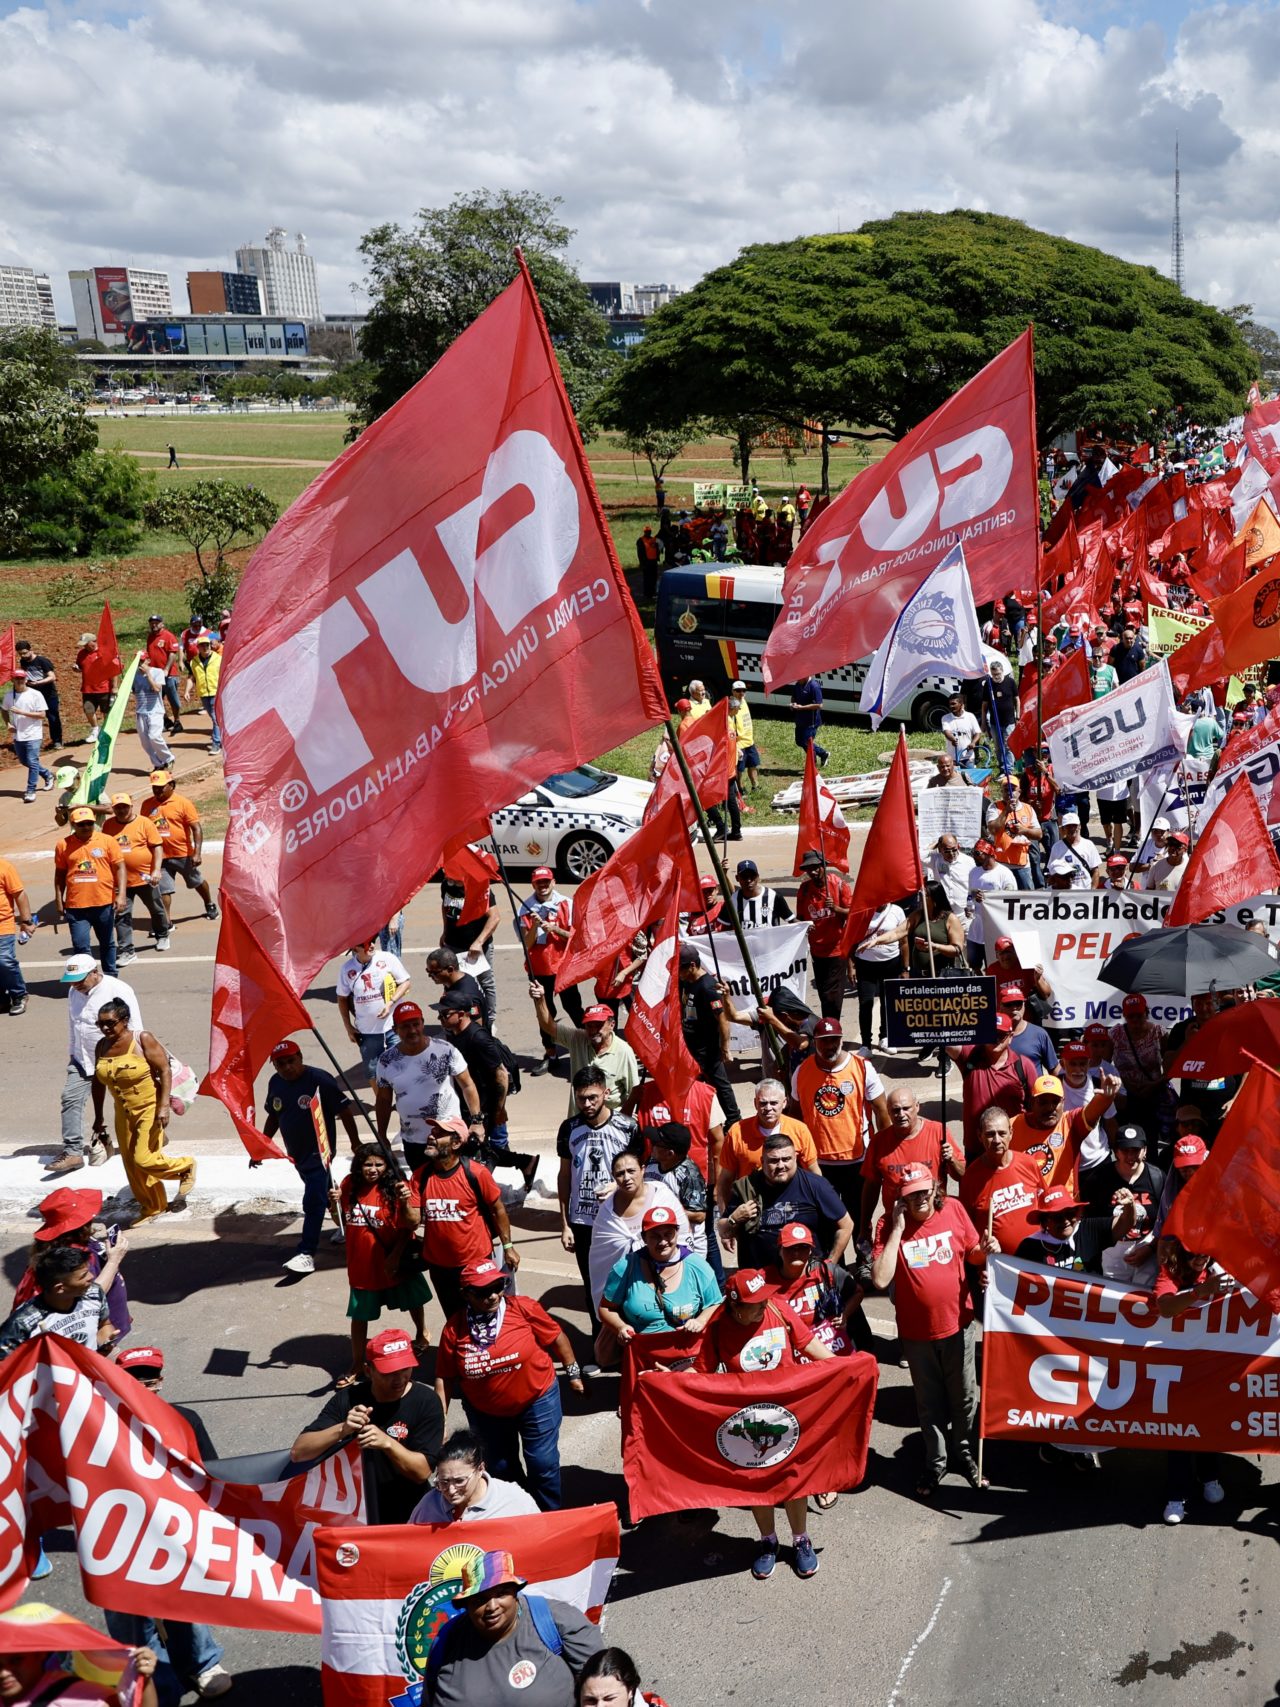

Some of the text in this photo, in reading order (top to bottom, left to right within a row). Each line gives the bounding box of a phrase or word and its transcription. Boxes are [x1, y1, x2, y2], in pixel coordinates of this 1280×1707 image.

[900, 984, 982, 995] Fortalecimento das
[895, 993, 989, 1013] NEGOCIAÇÕES
[638, 1011, 655, 1034] ÚNICA
[906, 1012, 978, 1028] COLETIVAS
[1182, 1060, 1206, 1073] CUT
[818, 1085, 841, 1095] FORÇA
[992, 1182, 1025, 1199] CUT
[425, 1198, 460, 1212] CUT
[1011, 1270, 1158, 1328] PELO
[464, 1352, 519, 1370] quero passar
[1028, 1353, 1182, 1414] CUT
[1007, 1408, 1200, 1438] SANTA CATARINA
